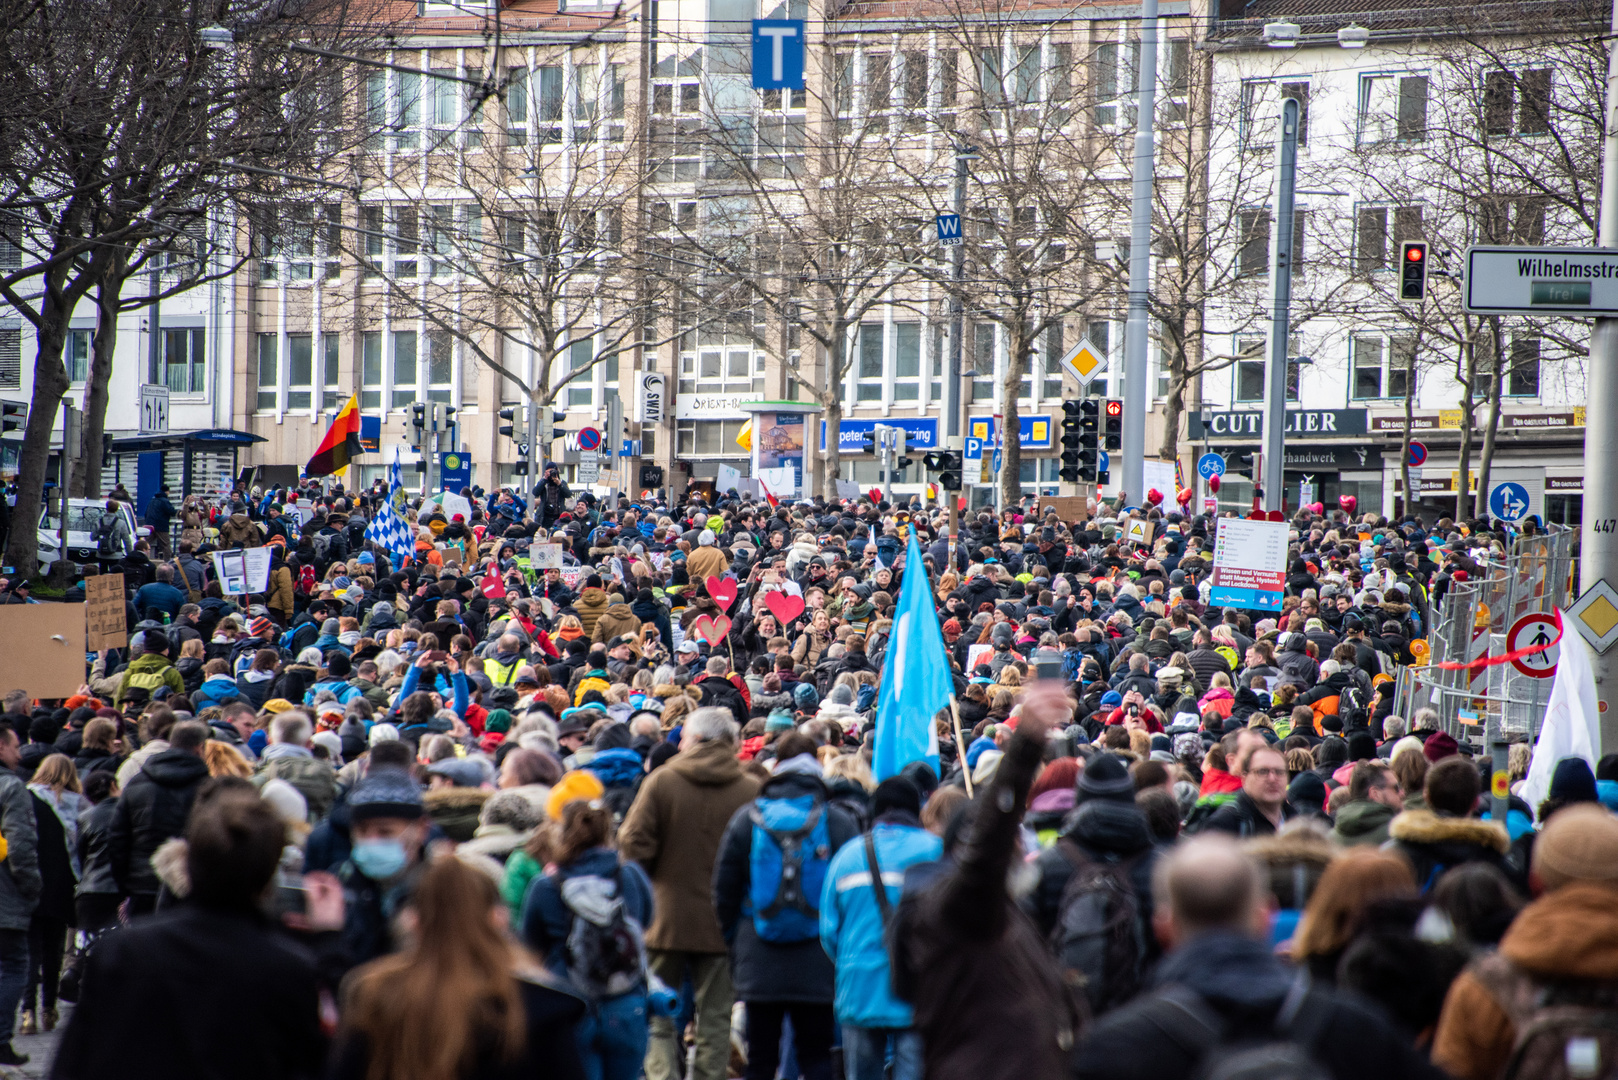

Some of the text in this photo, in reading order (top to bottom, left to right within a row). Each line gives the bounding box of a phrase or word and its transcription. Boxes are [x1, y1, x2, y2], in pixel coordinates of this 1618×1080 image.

[758, 27, 797, 81] T
[939, 217, 958, 236] W
[942, 238, 960, 246] 833
[1549, 287, 1574, 300] frei
[646, 392, 660, 421] SWAY
[967, 439, 979, 457] P
[644, 470, 660, 484] sky
[1593, 519, 1617, 534] 447
[1220, 567, 1241, 575] Wissen
[1253, 570, 1278, 578] Vernunft
[1230, 580, 1260, 589] Lockdown
[1256, 576, 1281, 585] Hysterie
